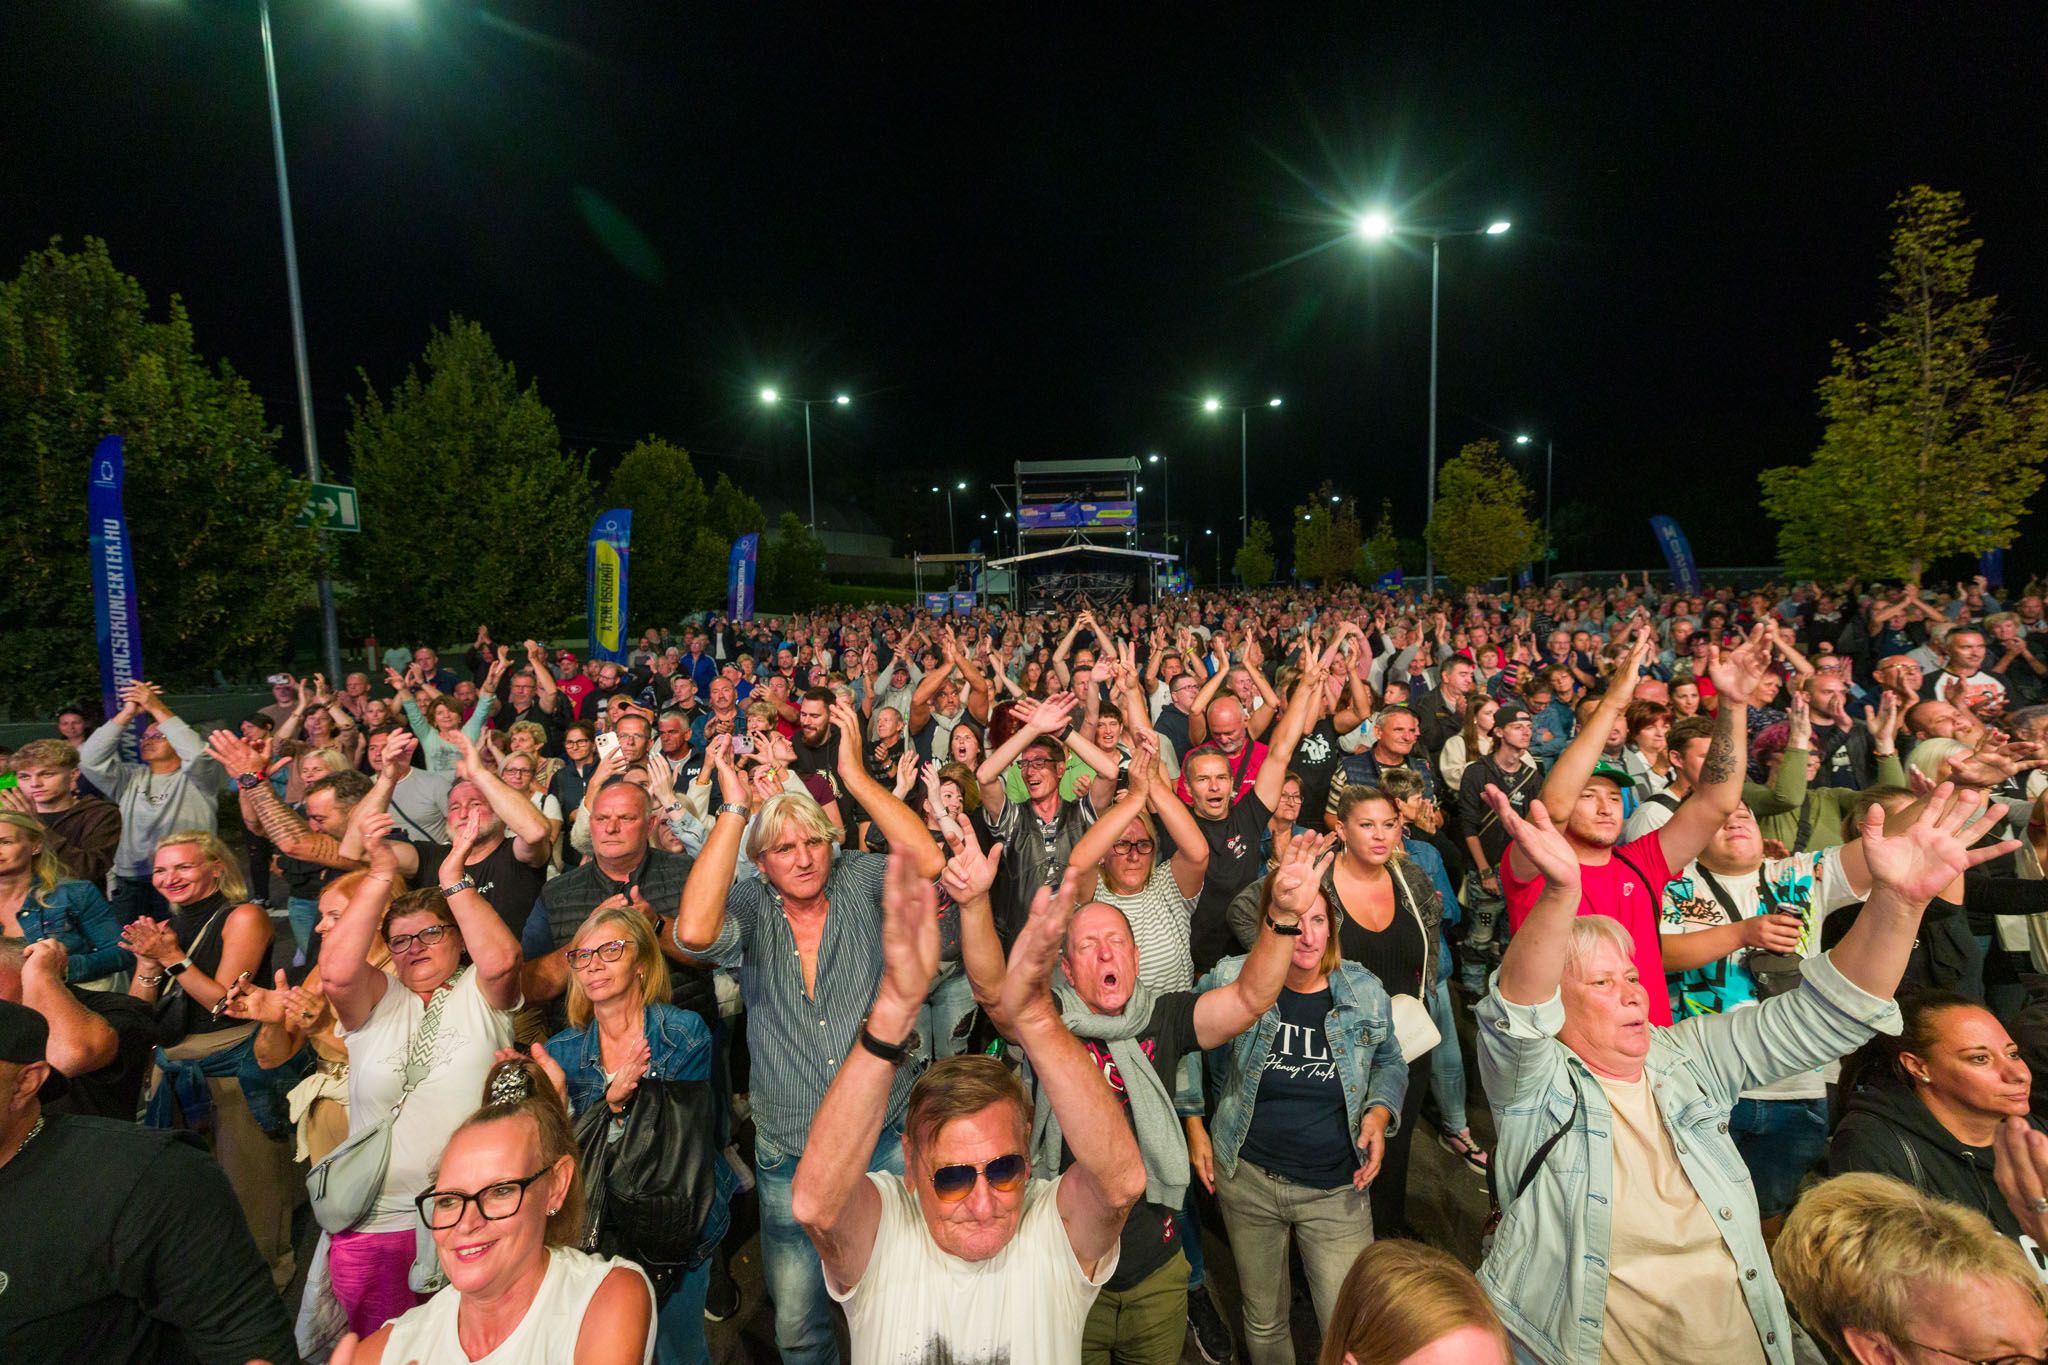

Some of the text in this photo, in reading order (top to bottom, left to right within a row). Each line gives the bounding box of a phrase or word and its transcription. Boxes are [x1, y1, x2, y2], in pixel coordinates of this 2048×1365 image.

[103, 518, 138, 763] WWSRENCSEKONCERTEK.HU
[1277, 1021, 1328, 1060] TL
[1264, 1053, 1336, 1082] Heavy Tools
